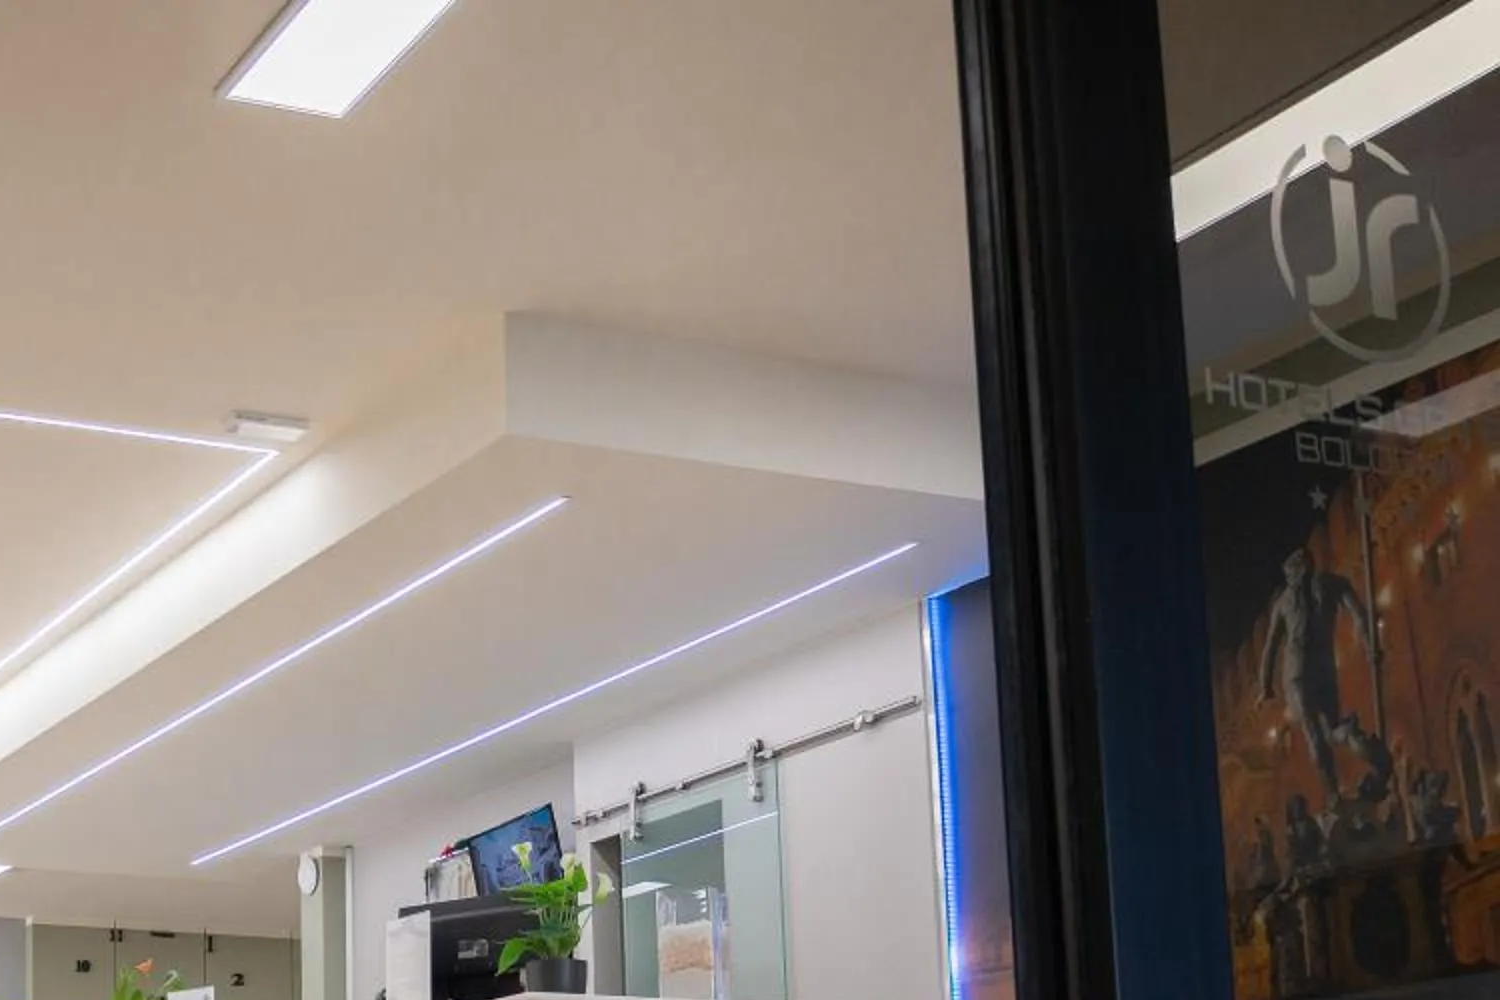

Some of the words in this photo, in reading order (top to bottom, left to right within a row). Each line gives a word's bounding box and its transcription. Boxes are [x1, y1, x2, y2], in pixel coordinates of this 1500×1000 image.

[109, 929, 123, 943] 11
[75, 960, 92, 973] 10
[230, 972, 245, 987] 2
